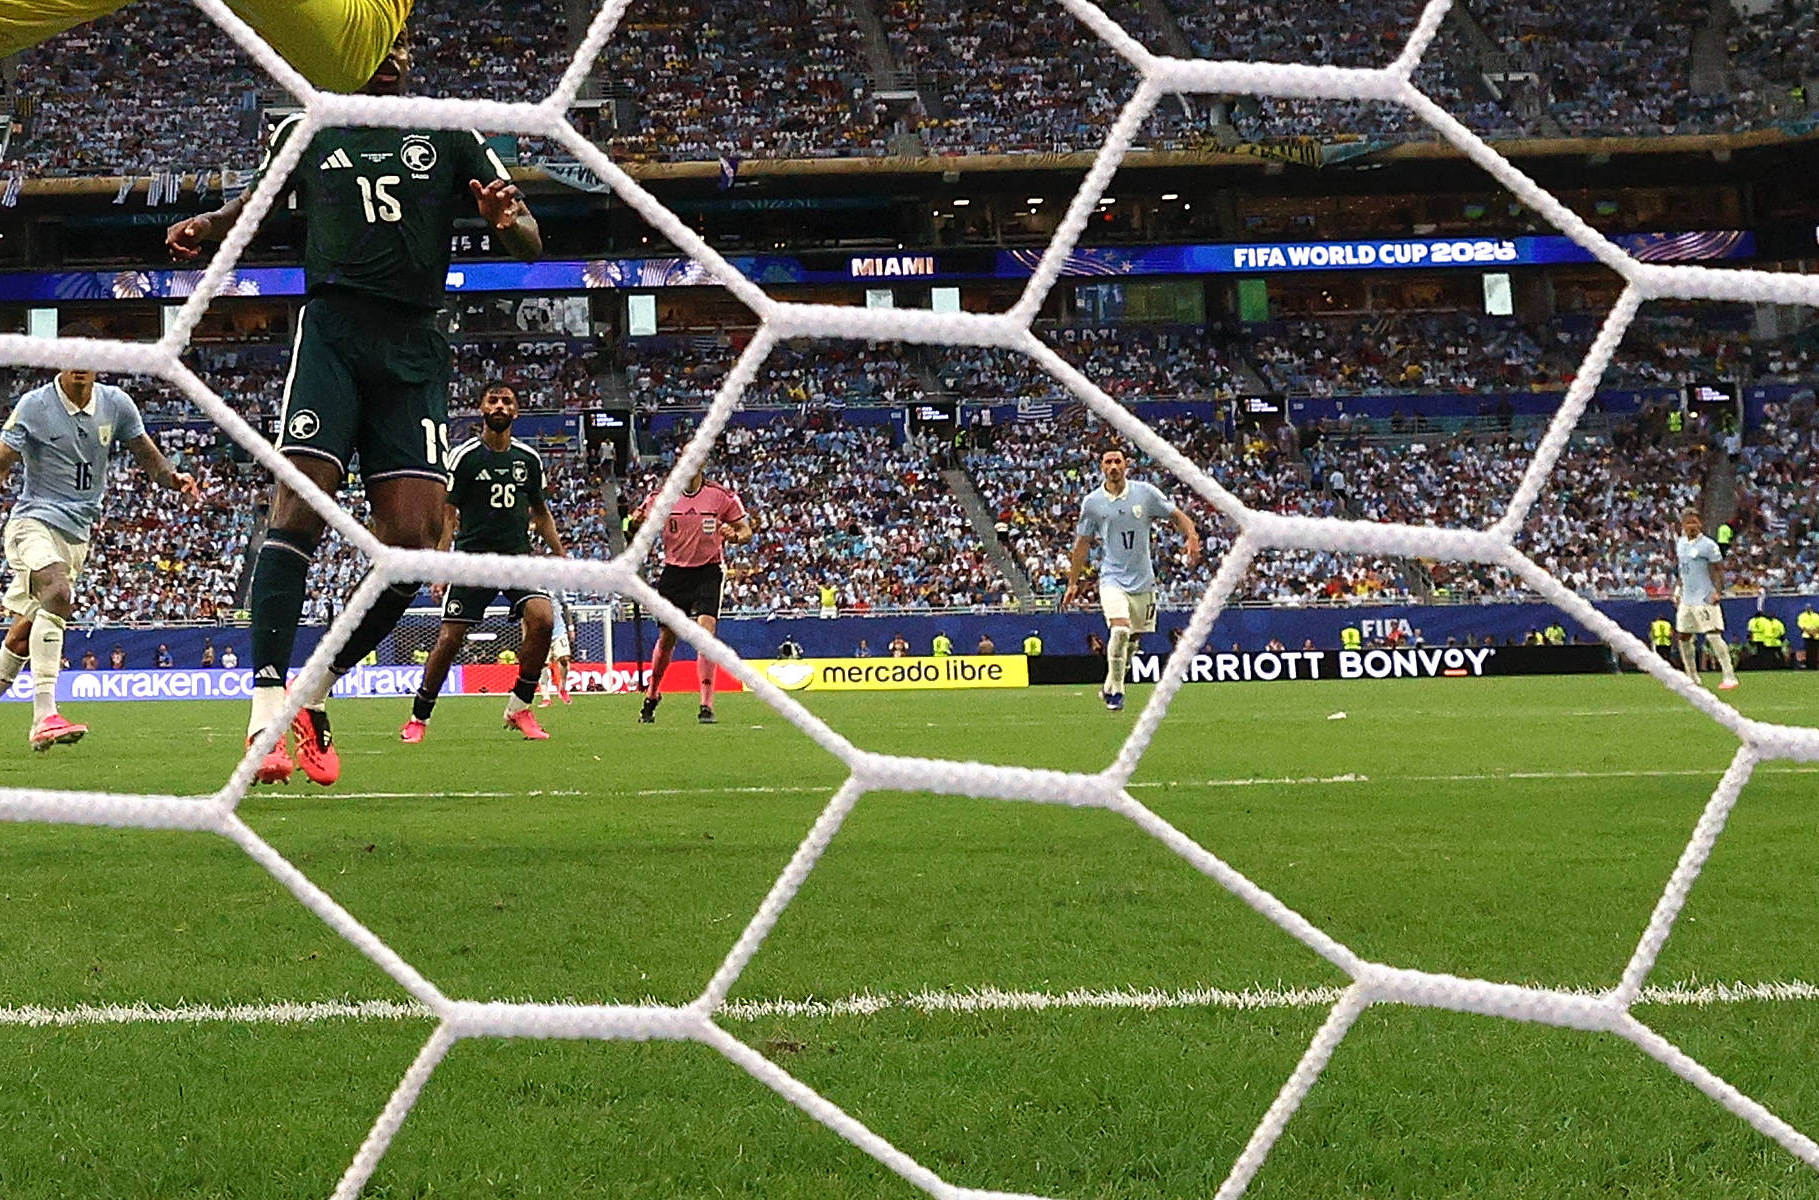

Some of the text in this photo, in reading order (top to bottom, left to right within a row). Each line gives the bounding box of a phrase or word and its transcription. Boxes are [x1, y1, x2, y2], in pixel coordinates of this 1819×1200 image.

[356, 175, 402, 224] 15
[852, 256, 934, 276] MIAMI
[1234, 240, 1517, 268] FIFA WORLD CUP 2026
[75, 462, 93, 491] 16
[490, 483, 516, 508] 26
[1121, 530, 1135, 550] 17
[823, 660, 1003, 683] mercado libre
[1132, 651, 1325, 682] MRRIOTT
[102, 672, 255, 698] kraken.co
